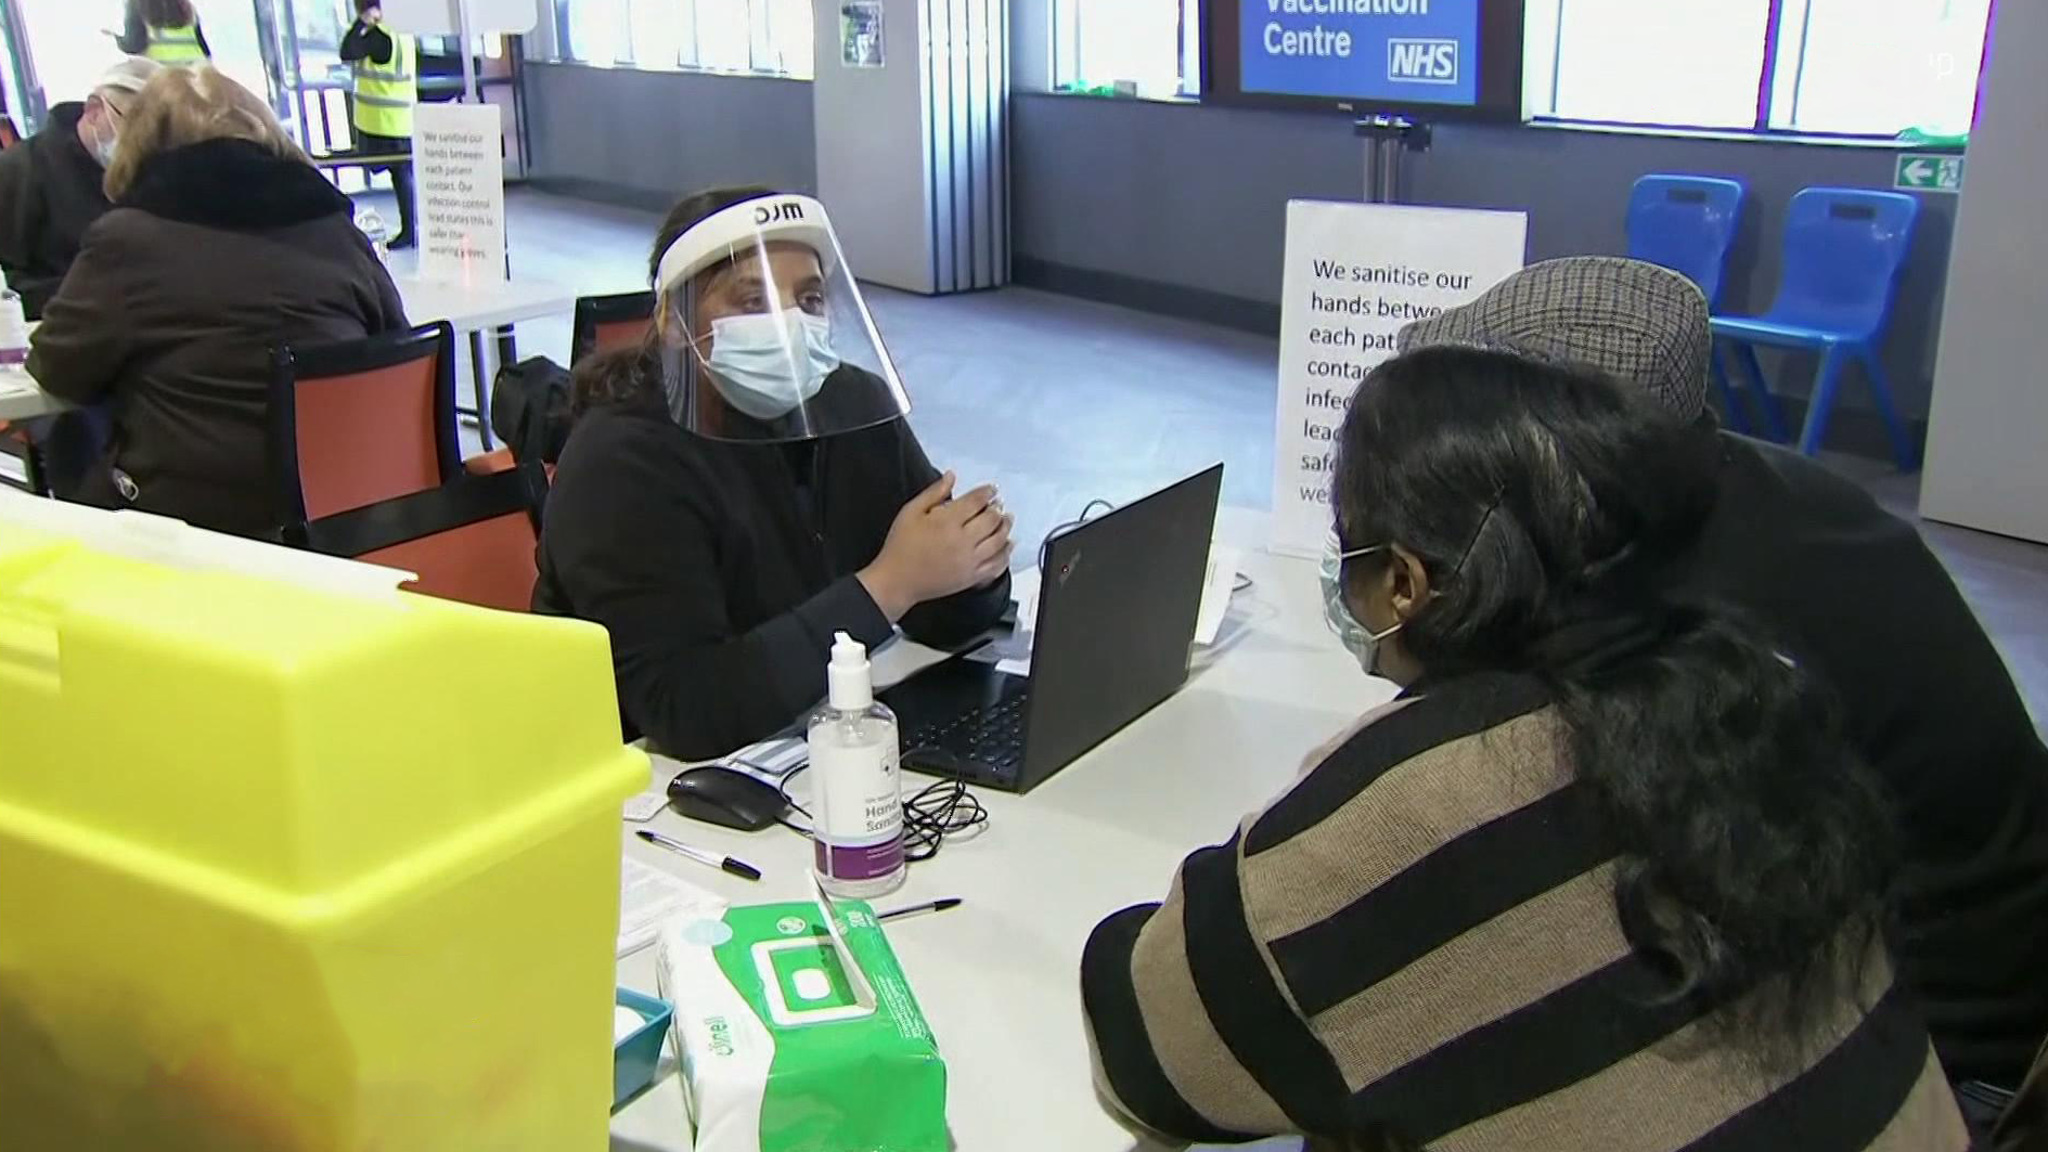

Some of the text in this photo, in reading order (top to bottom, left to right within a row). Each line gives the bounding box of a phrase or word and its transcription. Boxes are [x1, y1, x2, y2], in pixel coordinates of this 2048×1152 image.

[1263, 21, 1351, 57] Centre
[1391, 43, 1454, 78] NHS
[423, 131, 437, 142] We
[425, 147, 484, 160] hands between
[1313, 259, 1472, 290] We sanitise our
[1311, 291, 1371, 315] hands
[1309, 326, 1355, 346] each
[865, 797, 898, 818] Hand
